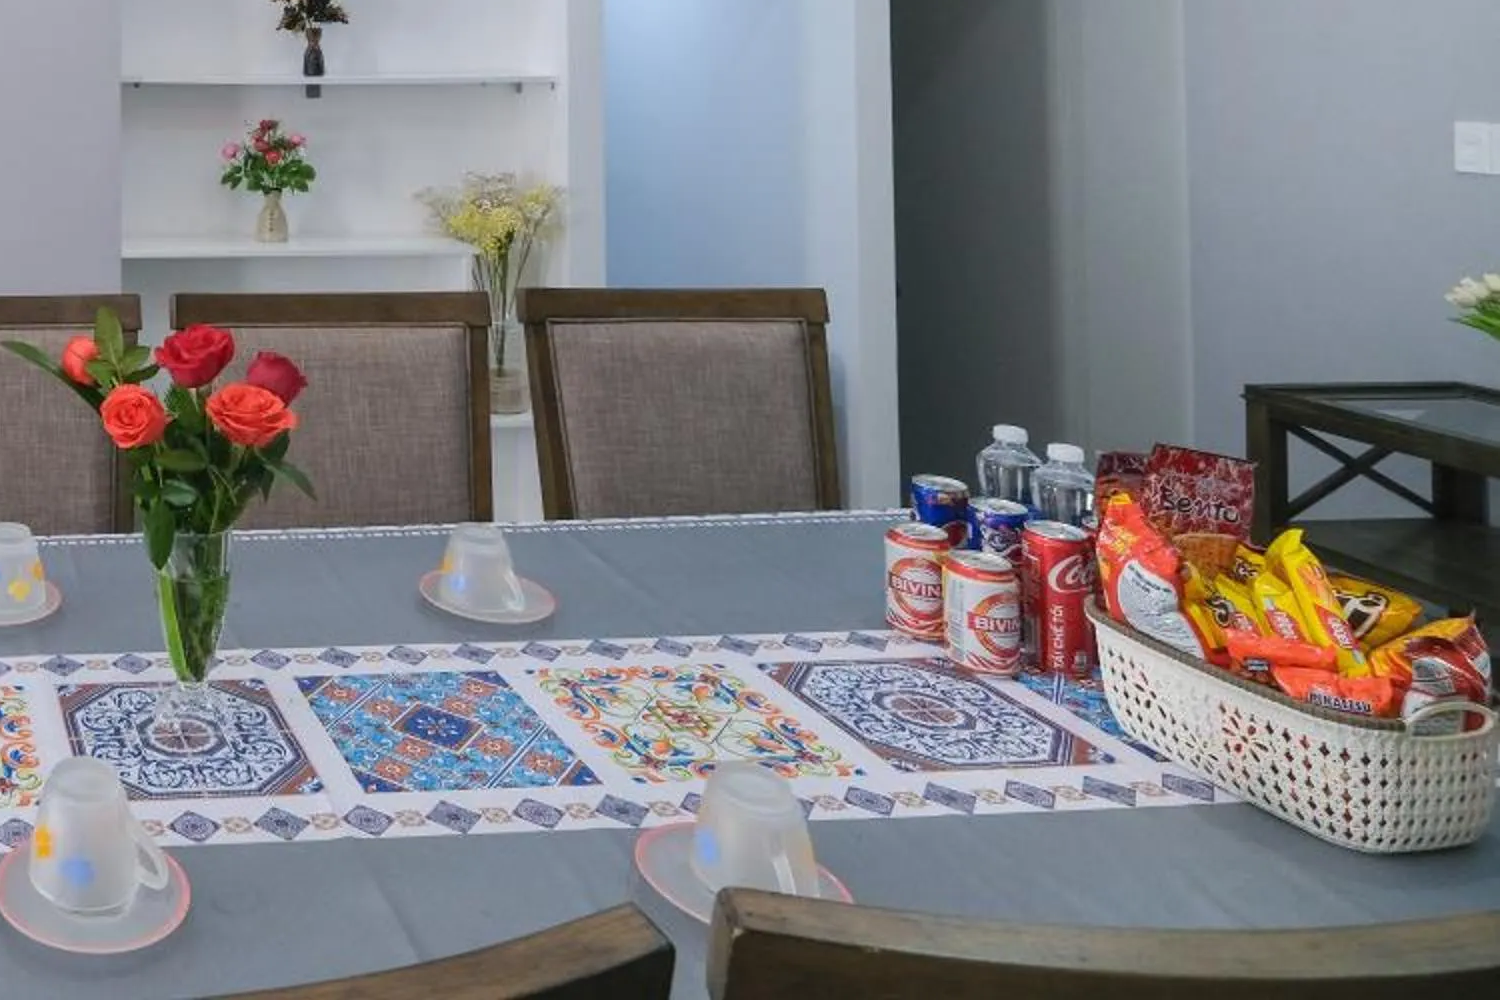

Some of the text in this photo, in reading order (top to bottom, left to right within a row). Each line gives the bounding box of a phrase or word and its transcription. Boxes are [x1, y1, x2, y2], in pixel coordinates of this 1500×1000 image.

[1161, 486, 1241, 523] Bento
[891, 575, 941, 597] BIVIN
[976, 617, 1020, 633] BIVIN
